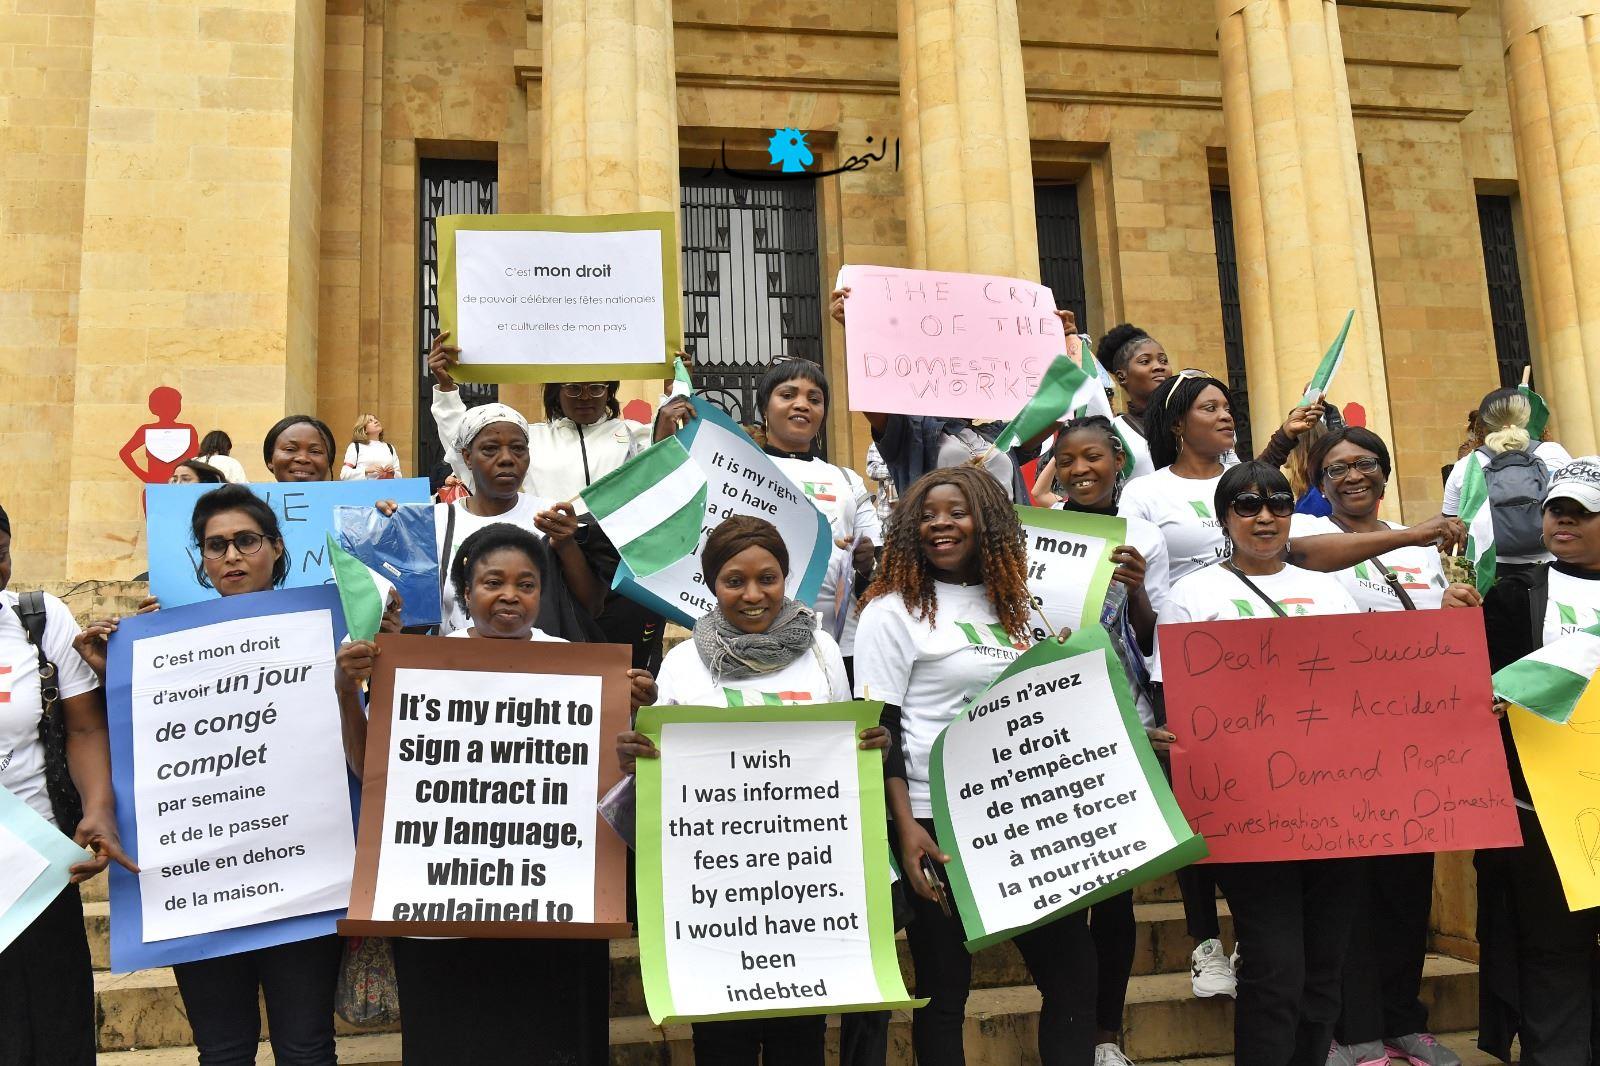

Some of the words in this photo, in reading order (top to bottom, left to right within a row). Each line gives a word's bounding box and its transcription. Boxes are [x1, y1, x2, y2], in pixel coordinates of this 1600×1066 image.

[505, 267, 531, 277] C'est
[534, 265, 570, 277] mon
[576, 264, 612, 278] droit
[462, 294, 477, 303] de
[479, 294, 518, 305] pouvoir
[521, 294, 561, 304] célébrer
[564, 296, 576, 304] les
[580, 294, 602, 305] fêtes
[606, 294, 656, 304] nationales
[864, 275, 949, 303] THE
[983, 282, 1038, 307] CRY
[498, 322, 508, 331] et
[510, 322, 559, 331] culturelles
[562, 322, 575, 332] de
[603, 322, 626, 332] pays
[921, 314, 967, 337] OF
[989, 317, 1056, 336] THE
[864, 352, 1041, 378] DOMESTIC
[910, 373, 1039, 400] WORKE
[712, 452, 724, 468] It
[727, 458, 739, 474] is
[742, 465, 766, 486] my
[768, 479, 798, 505] right
[722, 482, 738, 498] to
[742, 489, 779, 515] have
[1035, 536, 1088, 558] mon
[152, 651, 194, 669] C'est
[198, 643, 235, 661] mon
[239, 636, 281, 653] droit
[1183, 628, 1280, 677] Death
[1350, 630, 1466, 665] Suicide
[152, 684, 211, 705] d'avoir
[216, 673, 249, 694] un
[253, 662, 312, 694] jour
[1016, 673, 1082, 703] n'avez
[156, 721, 186, 742] de
[194, 702, 278, 734] congé
[399, 693, 441, 722] It's
[448, 699, 489, 725] my
[495, 697, 561, 727] right
[567, 700, 593, 726] to
[1006, 708, 1044, 736] pas
[1191, 695, 1275, 742] Death
[1352, 685, 1462, 719] Accident
[399, 734, 460, 765] sign
[467, 740, 483, 762] a
[490, 738, 589, 765] written
[730, 751, 735, 769] I
[742, 750, 791, 769] wish
[992, 747, 1012, 764] le
[1019, 727, 1071, 757] droit
[157, 742, 268, 781] complet
[959, 782, 984, 800] de
[990, 741, 1119, 790] m'empêcher
[1189, 763, 1245, 802] We
[1267, 750, 1381, 791] Demand
[158, 796, 186, 816] par
[192, 783, 266, 808] semaine
[415, 778, 537, 805] contract
[542, 778, 568, 805] in
[682, 784, 687, 803] I
[694, 785, 736, 802] was
[743, 780, 840, 802] informed
[986, 801, 1014, 819] de
[1020, 771, 1106, 810] manger
[669, 818, 714, 837] that
[721, 813, 848, 835] recruitment
[971, 831, 998, 850] ou
[1003, 823, 1030, 840] de
[1036, 811, 1069, 831] me
[1073, 787, 1138, 820] forcer
[1353, 797, 1400, 822] When
[159, 830, 176, 845] et
[181, 826, 203, 843] de
[208, 822, 224, 838] le
[229, 812, 289, 838] passer
[394, 820, 438, 847] my
[444, 817, 583, 849] language,
[1009, 850, 1025, 867] à
[1030, 820, 1118, 862] manger
[161, 858, 211, 878] seule
[215, 854, 238, 869] en
[242, 842, 306, 865] dehors
[427, 858, 514, 886] which
[521, 858, 546, 886] is
[694, 850, 739, 870] fees
[745, 850, 781, 868] are
[787, 845, 832, 870] paid
[998, 879, 1022, 898] la
[1028, 838, 1147, 890] nourriture
[164, 895, 185, 911] de
[192, 890, 208, 906] la
[213, 879, 284, 904] maison.
[392, 898, 539, 922] explained
[546, 900, 574, 922] to
[692, 884, 718, 908] by
[725, 881, 844, 906] employers.
[1033, 893, 1062, 911] de
[675, 921, 680, 940] I
[688, 917, 758, 939] would
[764, 915, 816, 935] have
[823, 911, 859, 931] not
[741, 950, 796, 971] been
[727, 979, 828, 1002] indebted
